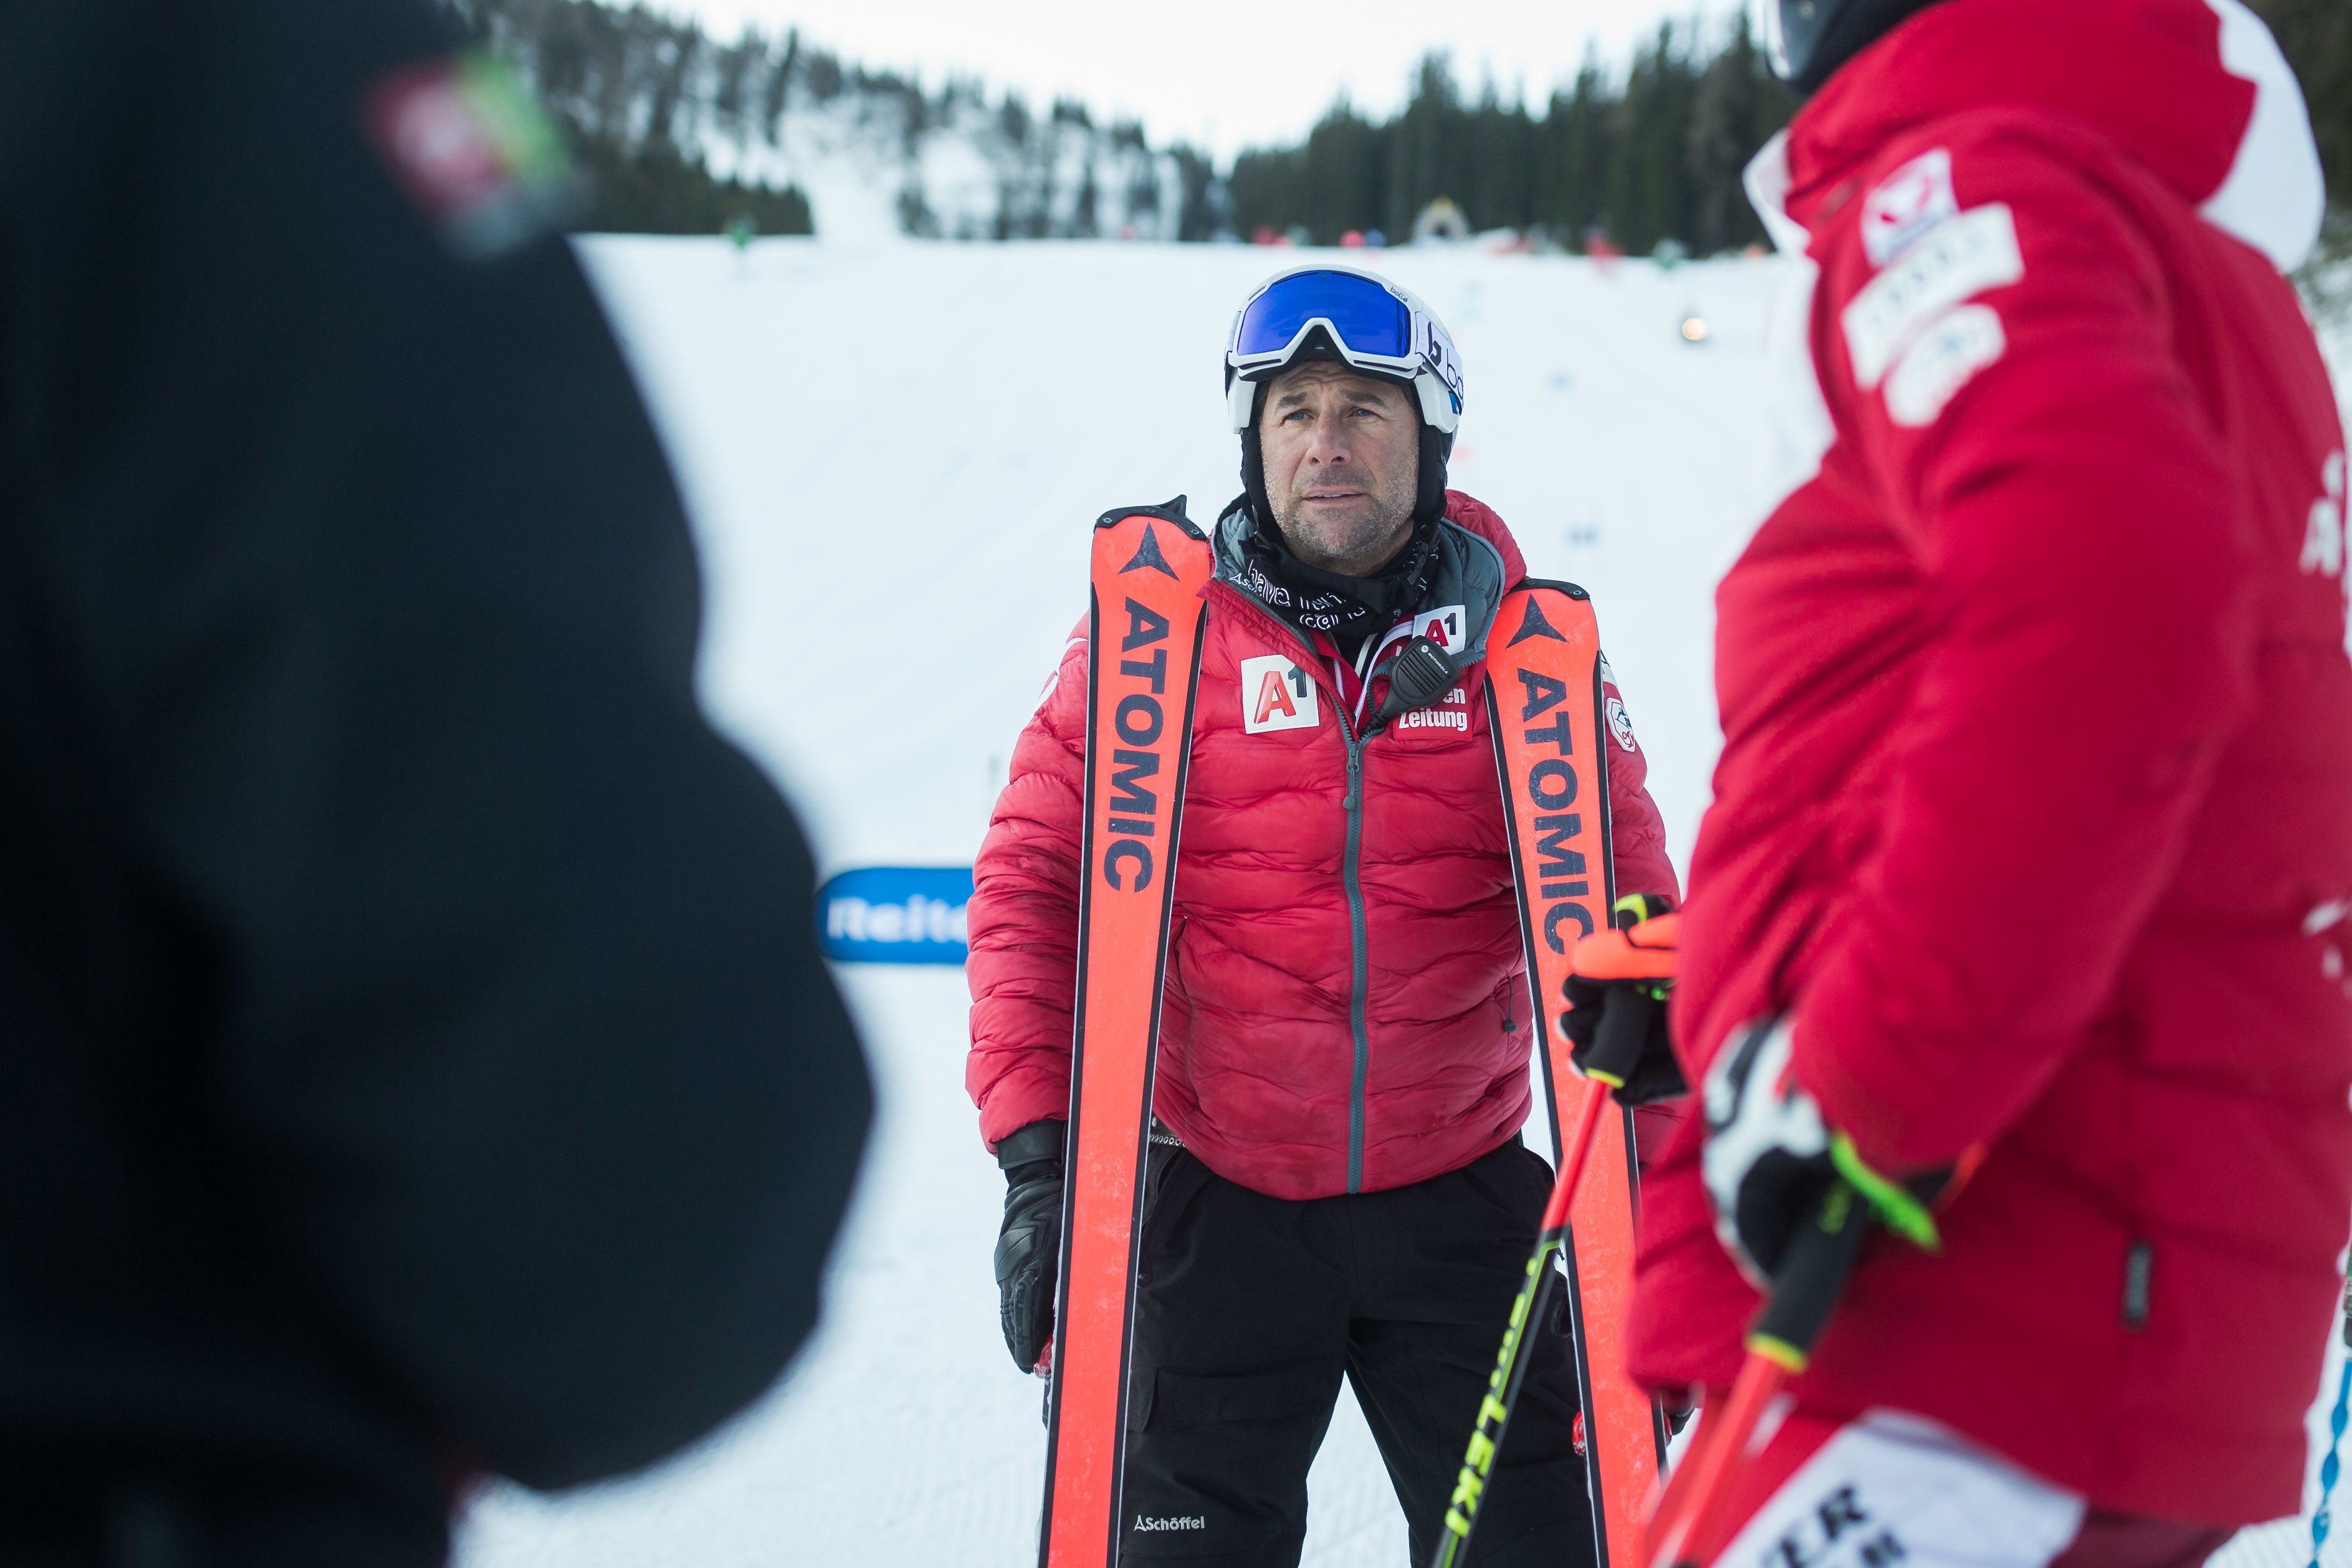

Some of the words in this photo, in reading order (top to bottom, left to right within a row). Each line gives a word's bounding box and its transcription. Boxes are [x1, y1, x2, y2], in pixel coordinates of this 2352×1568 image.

[1424, 612, 1457, 648] A1
[1427, 652, 1449, 675] MOTOROLA
[1253, 664, 1307, 724] A1
[1398, 708, 1468, 732] Zeitung
[1103, 596, 1170, 893] ATOMIC
[1517, 667, 1594, 955] ATOMIC
[1445, 1394, 1508, 1537] LEKI
[1145, 1516, 1205, 1531] Schöffel
